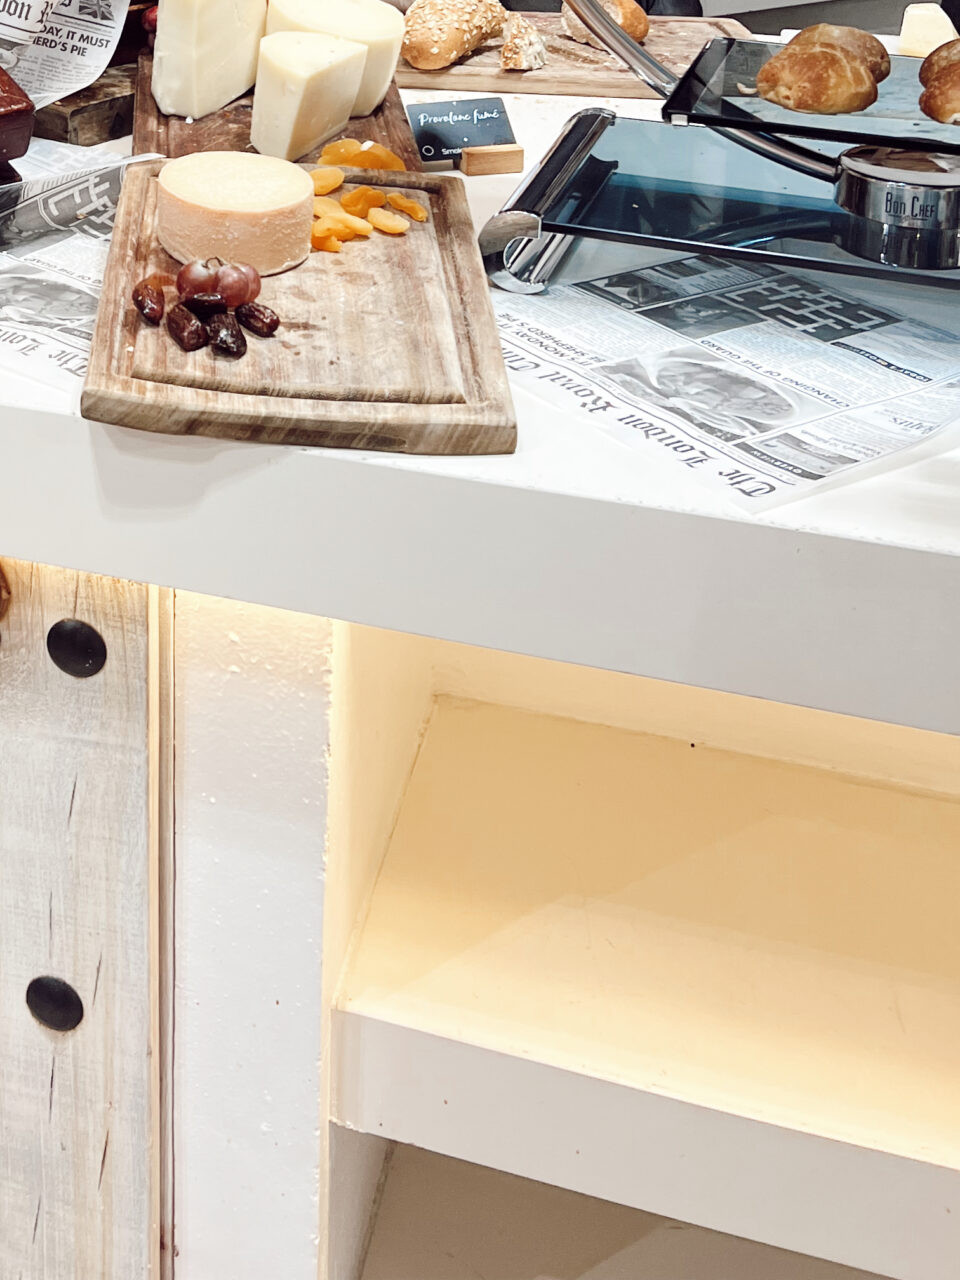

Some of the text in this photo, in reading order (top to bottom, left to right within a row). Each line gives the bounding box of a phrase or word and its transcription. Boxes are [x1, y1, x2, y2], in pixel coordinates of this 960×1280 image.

[66, 29, 77, 41] IT
[78, 33, 111, 49] MUST
[70, 44, 88, 57] PIE
[473, 108, 500, 125] fumé
[700, 339, 851, 409] CHANGING OF THE GUARD
[616, 414, 716, 468] London
[718, 469, 776, 497] The
